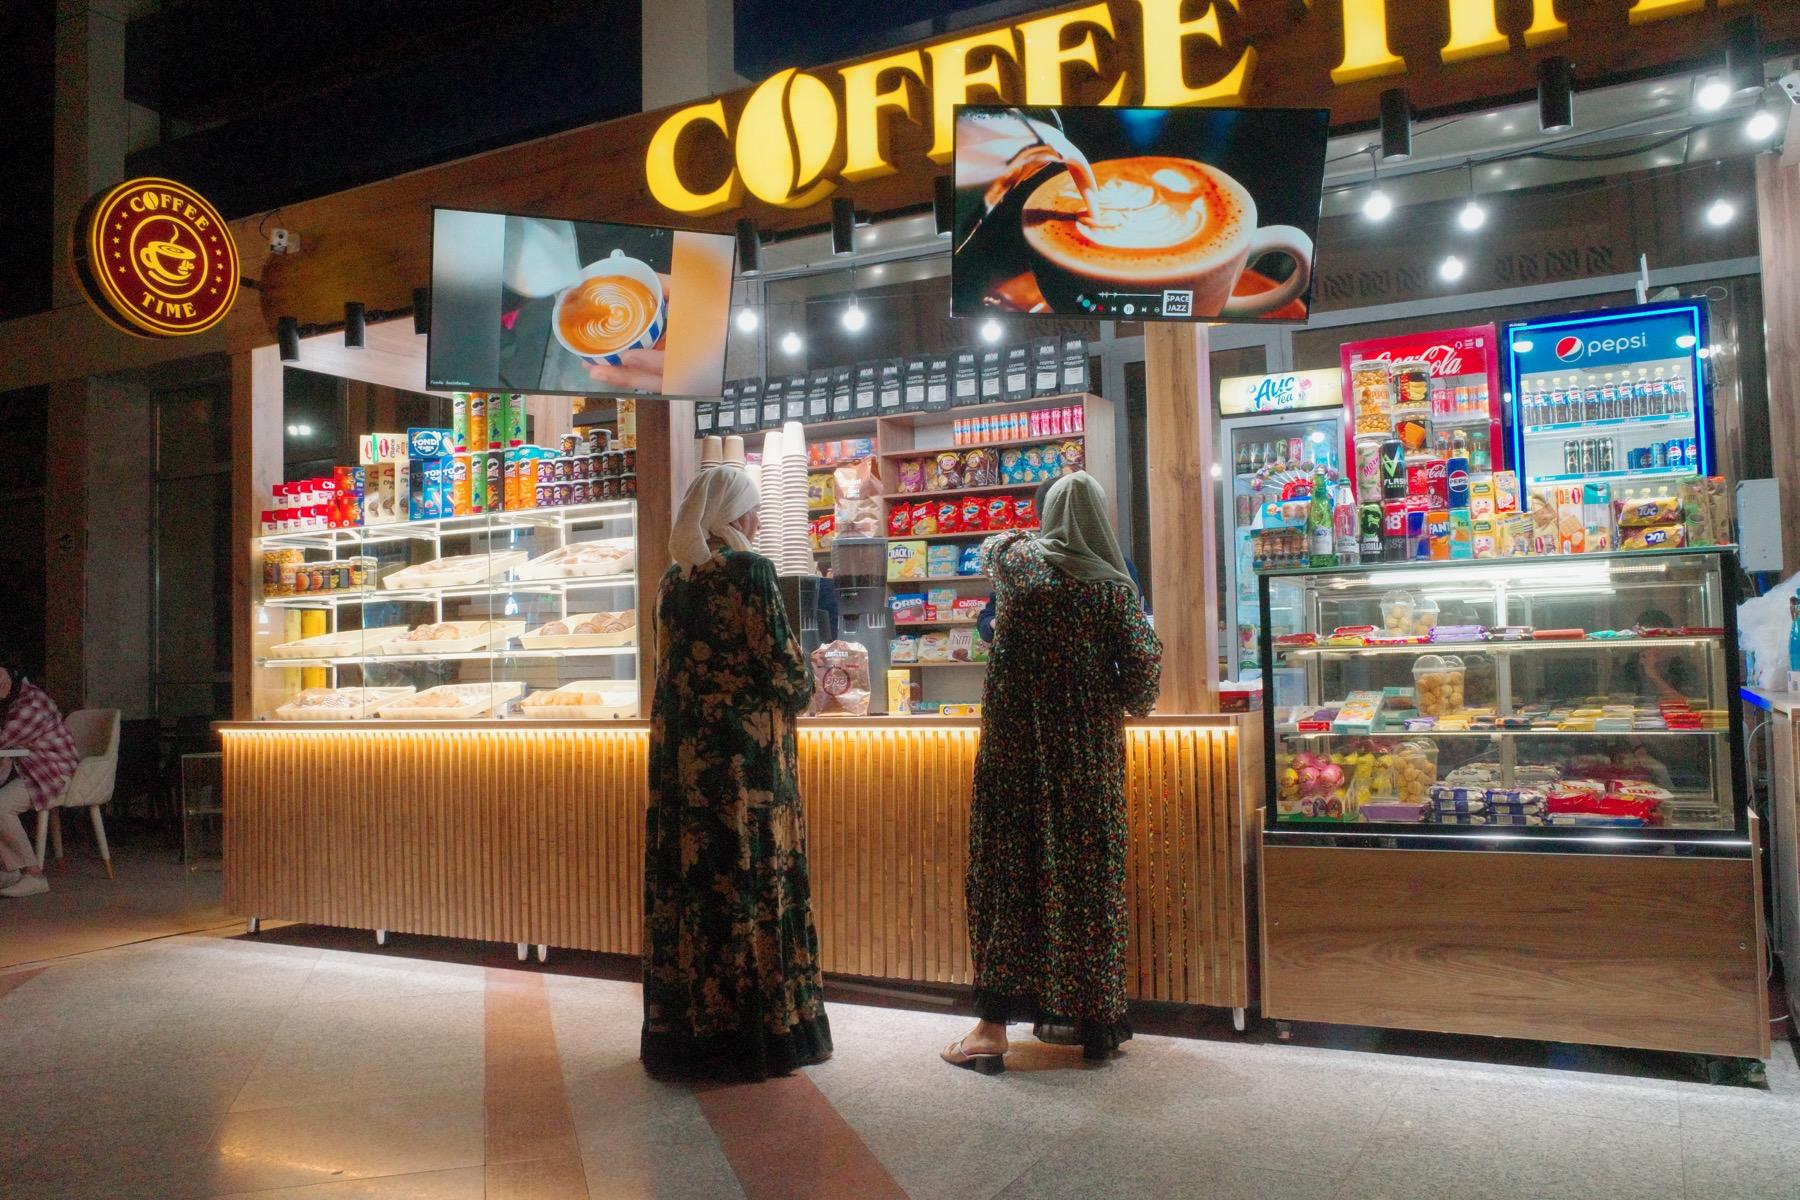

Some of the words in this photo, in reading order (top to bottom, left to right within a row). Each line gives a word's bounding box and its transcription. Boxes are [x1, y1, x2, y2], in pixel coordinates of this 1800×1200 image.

[646, 0, 1257, 212] COFFEE
[130, 191, 209, 232] COFFEE
[142, 291, 197, 319] TIME
[1166, 295, 1190, 303] SPACE
[1167, 304, 1187, 312] JAZZ
[1588, 332, 1646, 357] pepsi
[1375, 345, 1463, 377] C-Cola
[1429, 522, 1450, 535] FANT
[892, 598, 922, 610] OREO
